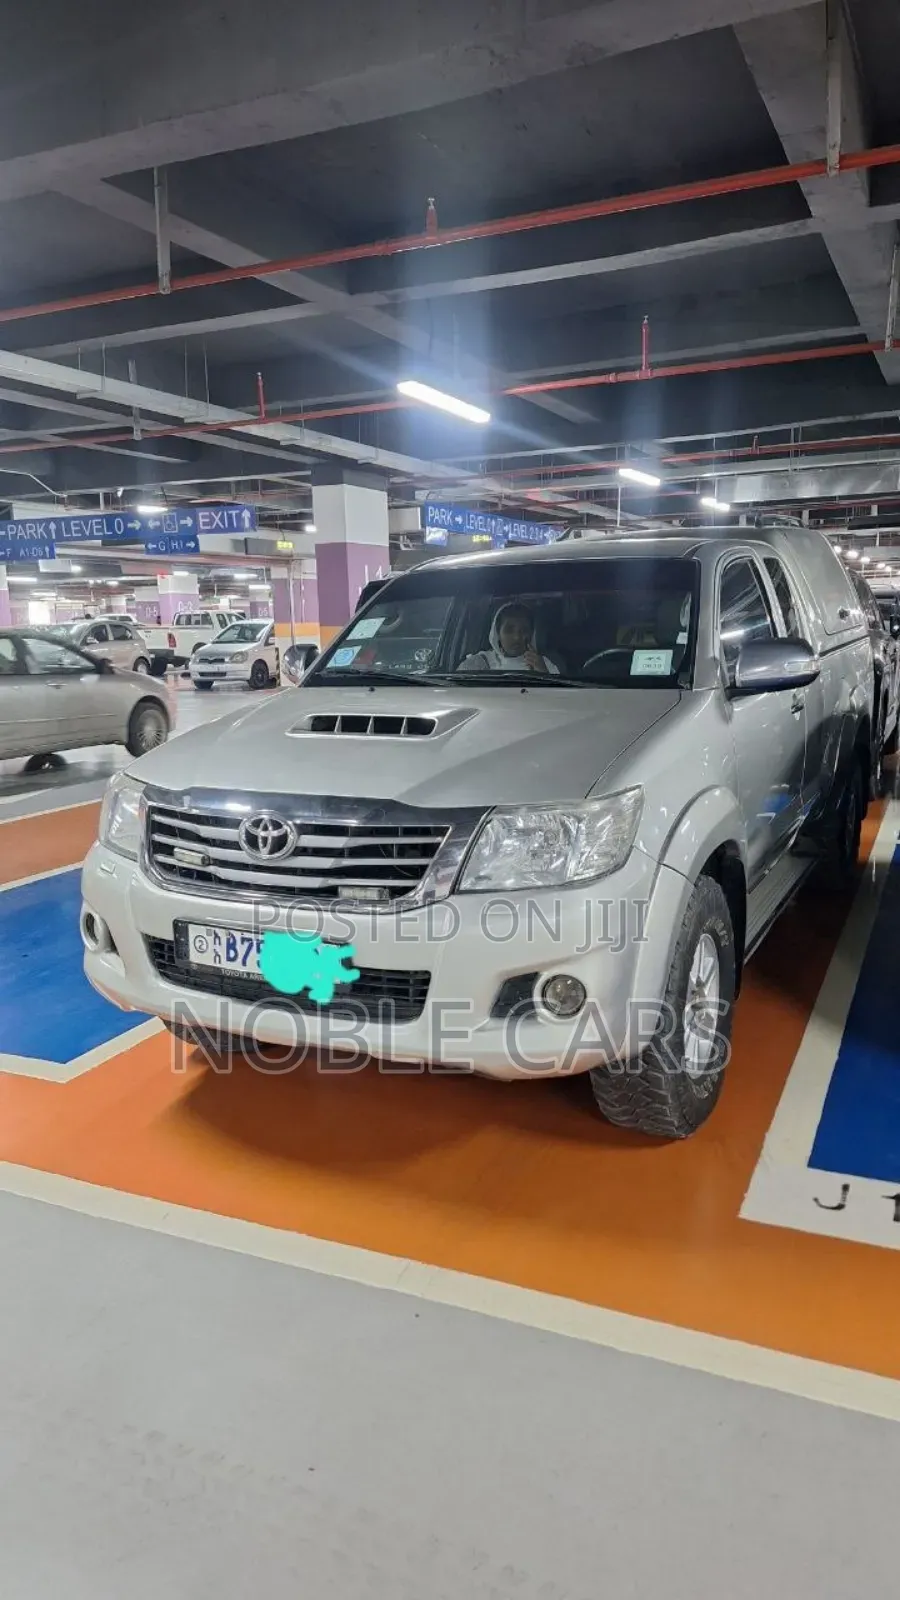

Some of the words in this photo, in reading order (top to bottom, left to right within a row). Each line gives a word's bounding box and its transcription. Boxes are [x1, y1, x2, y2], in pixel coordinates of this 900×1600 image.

[7, 521, 48, 540] PARK
[61, 519, 113, 537] LEVEL
[114, 518, 125, 535] 0
[199, 510, 240, 530] EXIT
[428, 506, 453, 526] PARK
[466, 513, 486, 532] LEVEL
[158, 540, 166, 551] G
[221, 968, 248, 978] TOYOTA
